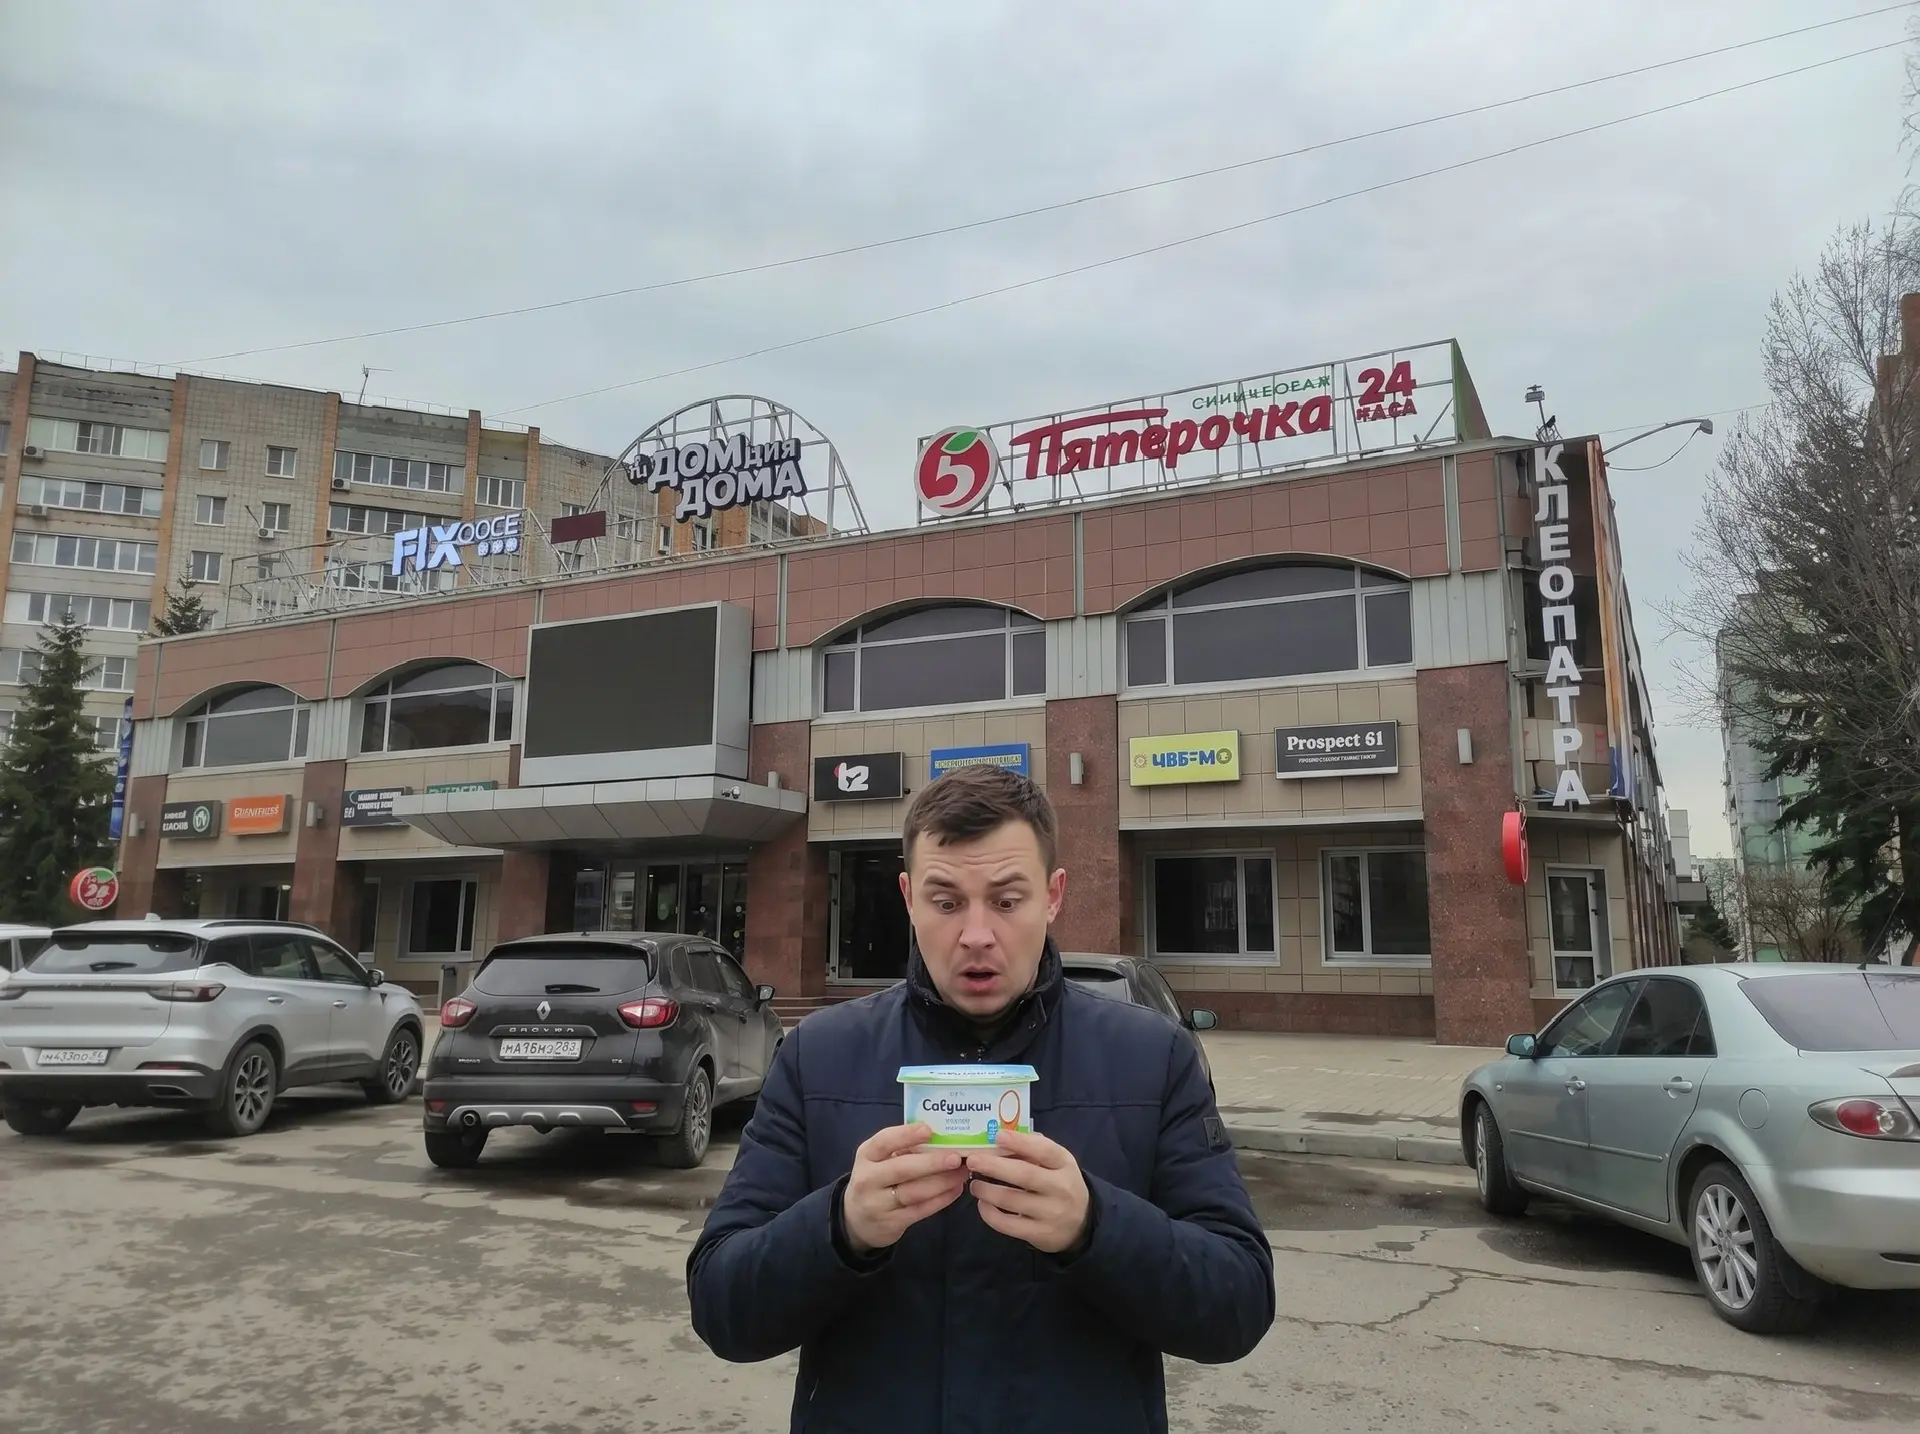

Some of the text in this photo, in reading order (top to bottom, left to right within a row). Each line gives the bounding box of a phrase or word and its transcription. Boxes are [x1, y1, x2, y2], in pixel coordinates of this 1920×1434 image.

[1357, 360, 1418, 406] 24
[1009, 394, 1332, 480] Пятерочка
[675, 460, 806, 520] ДОМА
[1533, 442, 1591, 808] КЛЕОПАТРА
[1286, 733, 1361, 752] Prospect
[922, 1098, 992, 1115] Савушкин
